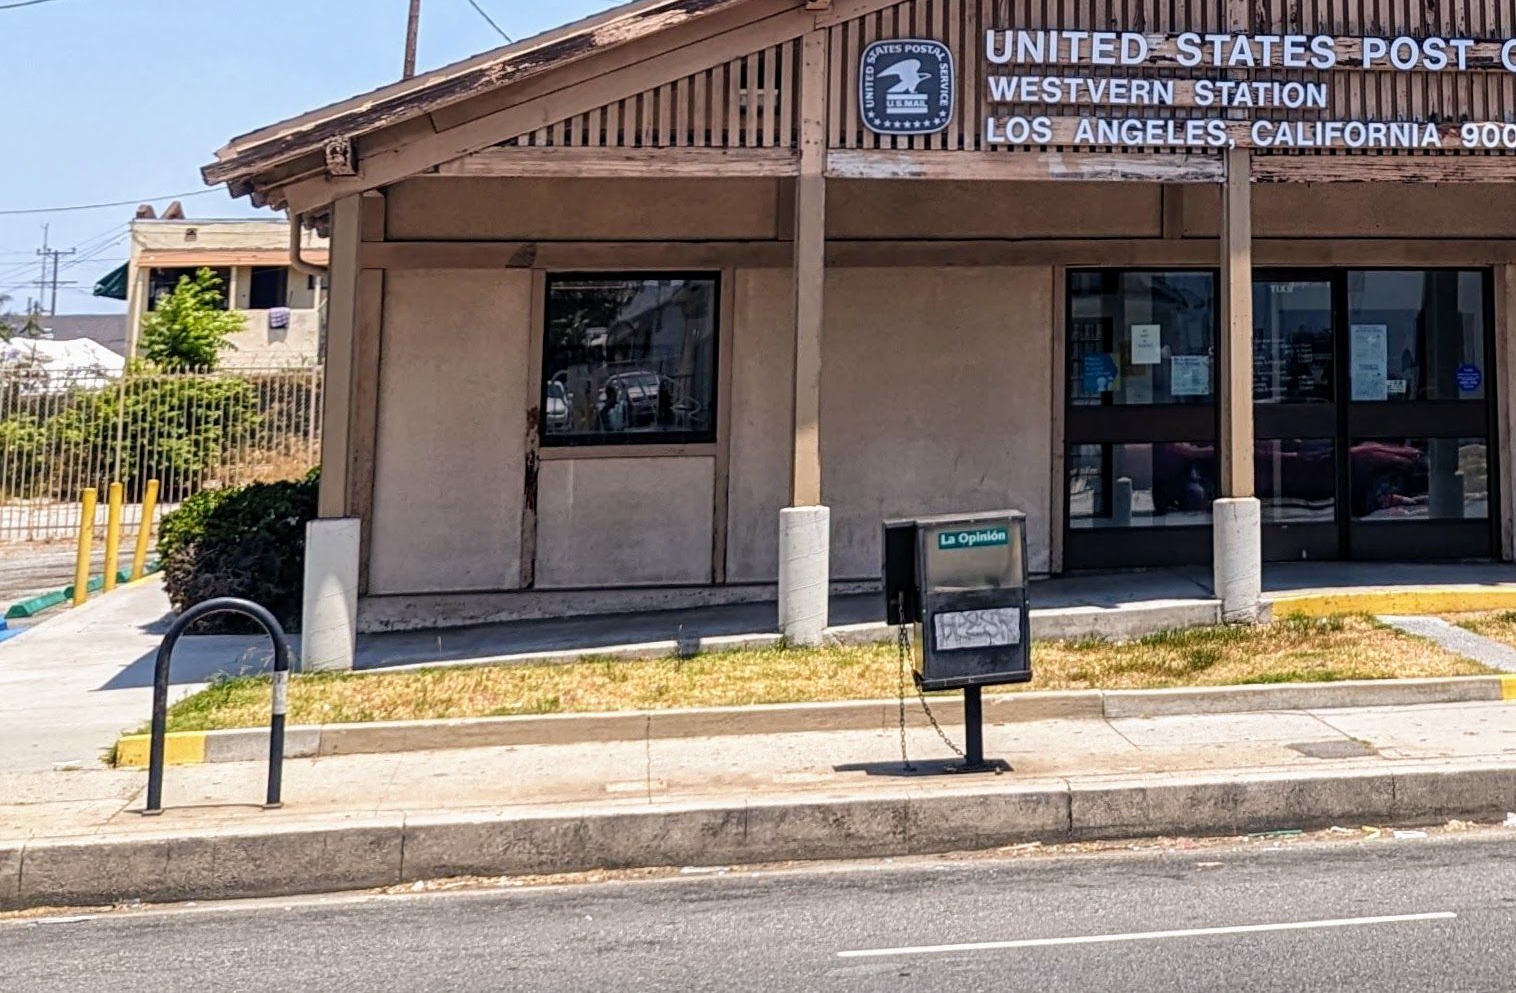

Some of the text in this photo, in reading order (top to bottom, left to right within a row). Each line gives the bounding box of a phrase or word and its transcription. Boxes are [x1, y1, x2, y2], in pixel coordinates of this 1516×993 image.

[986, 29, 1148, 65] UNITED
[1176, 32, 1336, 69] STATES
[1363, 36, 1474, 71] POST
[865, 45, 949, 108] UNITED STATES POSTAL SERVICE
[988, 76, 1327, 108] WESTVERN STATION
[987, 116, 1052, 143] LOS
[1074, 118, 1236, 150] ANGELES,
[1251, 120, 1442, 147] CALIFORNIA
[941, 529, 1006, 546] La Opinión
